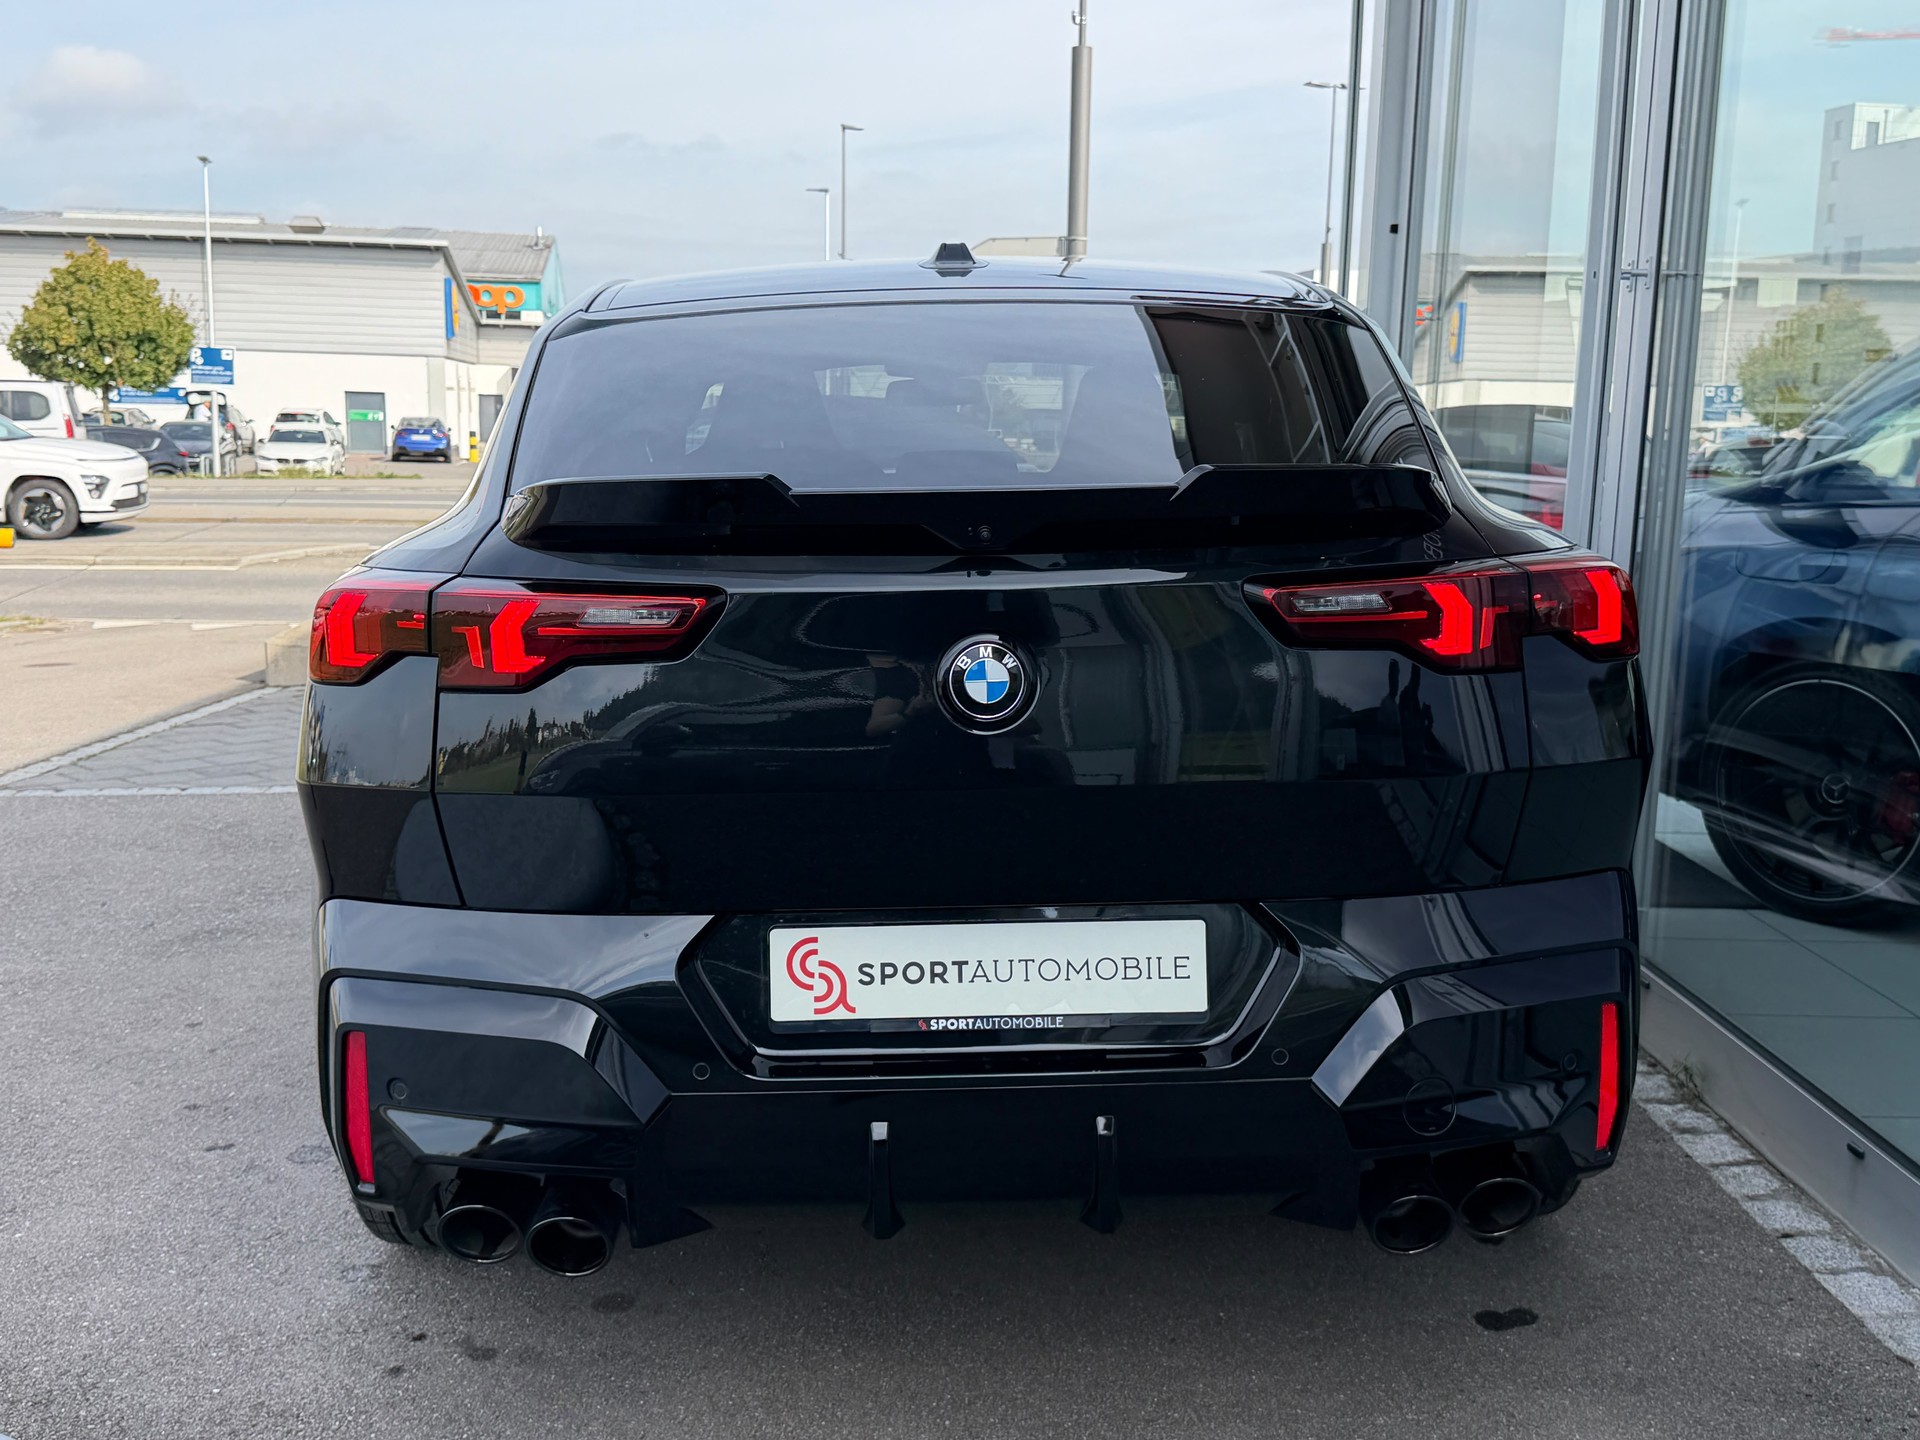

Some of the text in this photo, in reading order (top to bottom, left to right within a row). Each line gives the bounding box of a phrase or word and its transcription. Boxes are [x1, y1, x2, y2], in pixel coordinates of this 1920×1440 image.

[467, 284, 525, 314] op
[957, 646, 1018, 670] BMW
[857, 956, 1191, 986] SPORTAUTOMOBILE
[930, 1016, 1064, 1031] SPORTAUTOMOBILE
